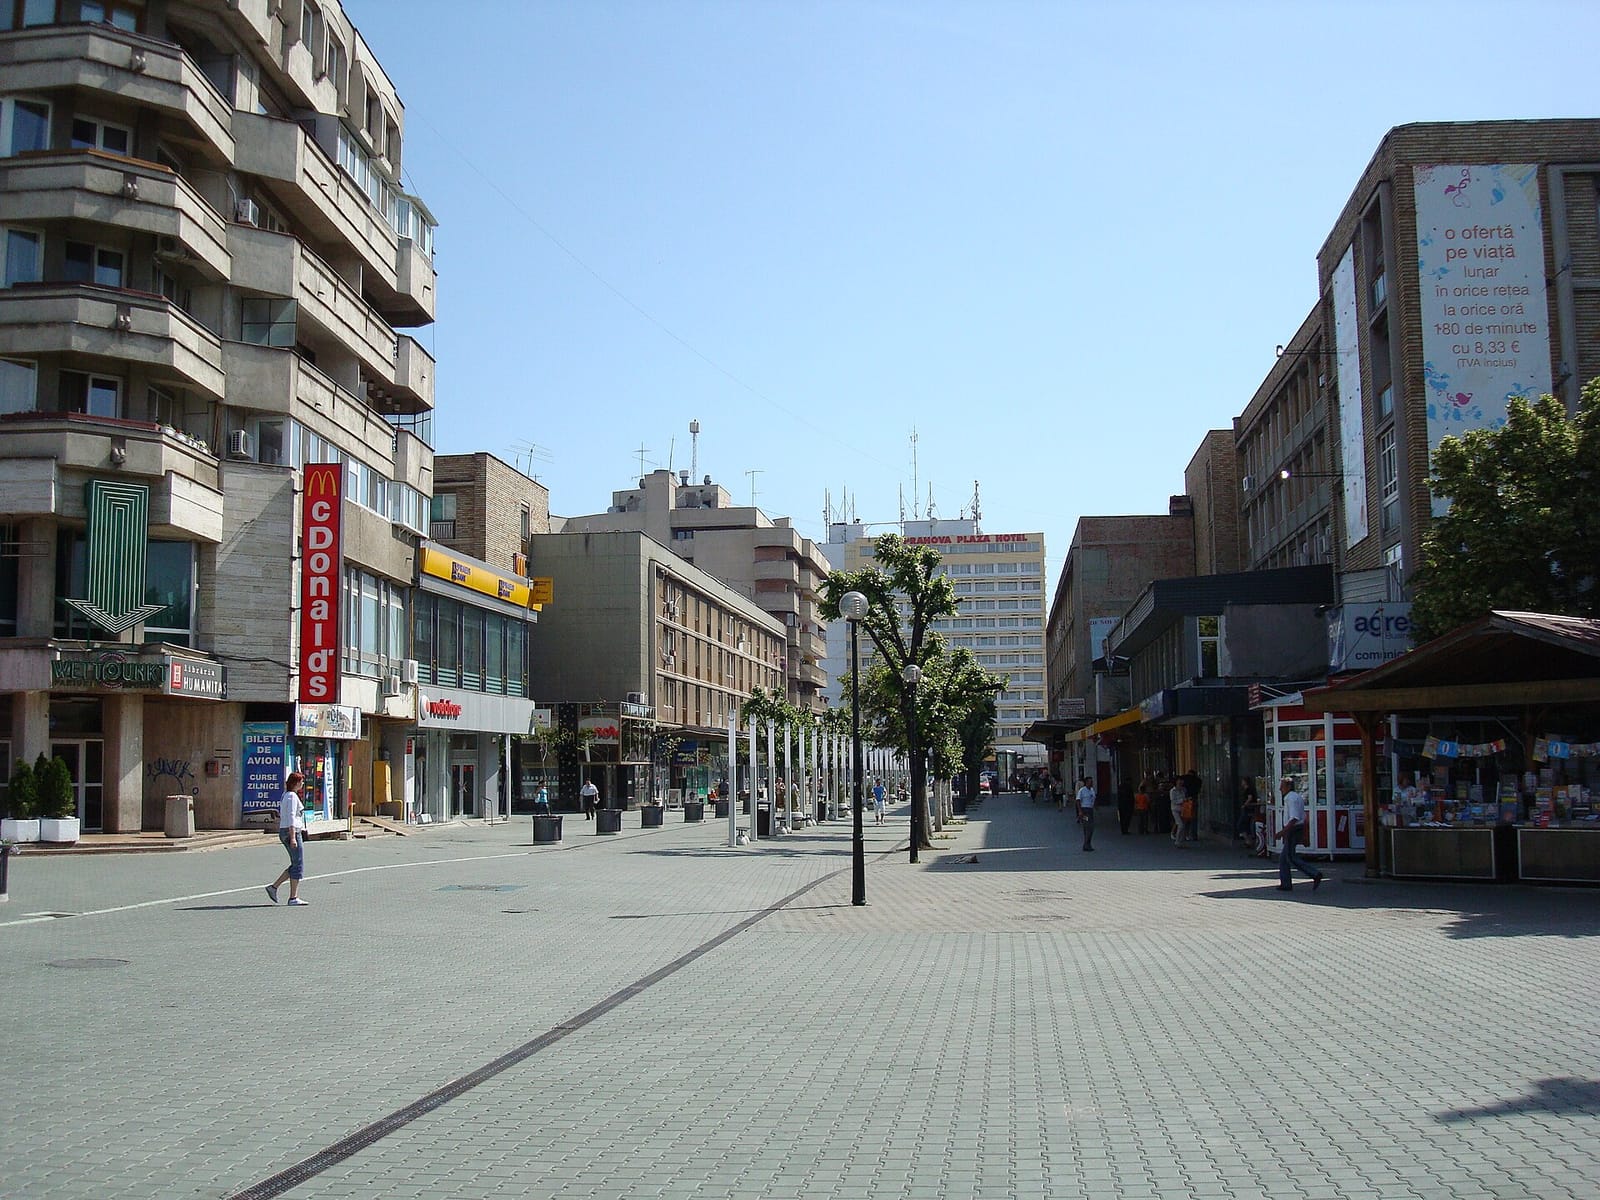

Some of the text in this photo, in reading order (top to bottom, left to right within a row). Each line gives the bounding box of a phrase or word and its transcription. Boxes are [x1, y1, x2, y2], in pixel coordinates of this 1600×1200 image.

[1445, 224, 1514, 240] o ofertă
[1446, 243, 1516, 263] pe viață
[1463, 265, 1500, 278] lunar
[1434, 284, 1448, 297] în
[1453, 284, 1489, 297] orice
[1443, 303, 1456, 316] la
[1460, 303, 1496, 316] orice
[1434, 321, 1537, 335] 180 de minute
[1452, 340, 1520, 355] cu 8,33 €
[903, 533, 1028, 545] PRAHOVA PLAZA HOTEL
[183, 676, 228, 695] HUMANITAS
[246, 735, 283, 743] BILETE
[257, 746, 272, 754] DE
[247, 757, 280, 765] AVION
